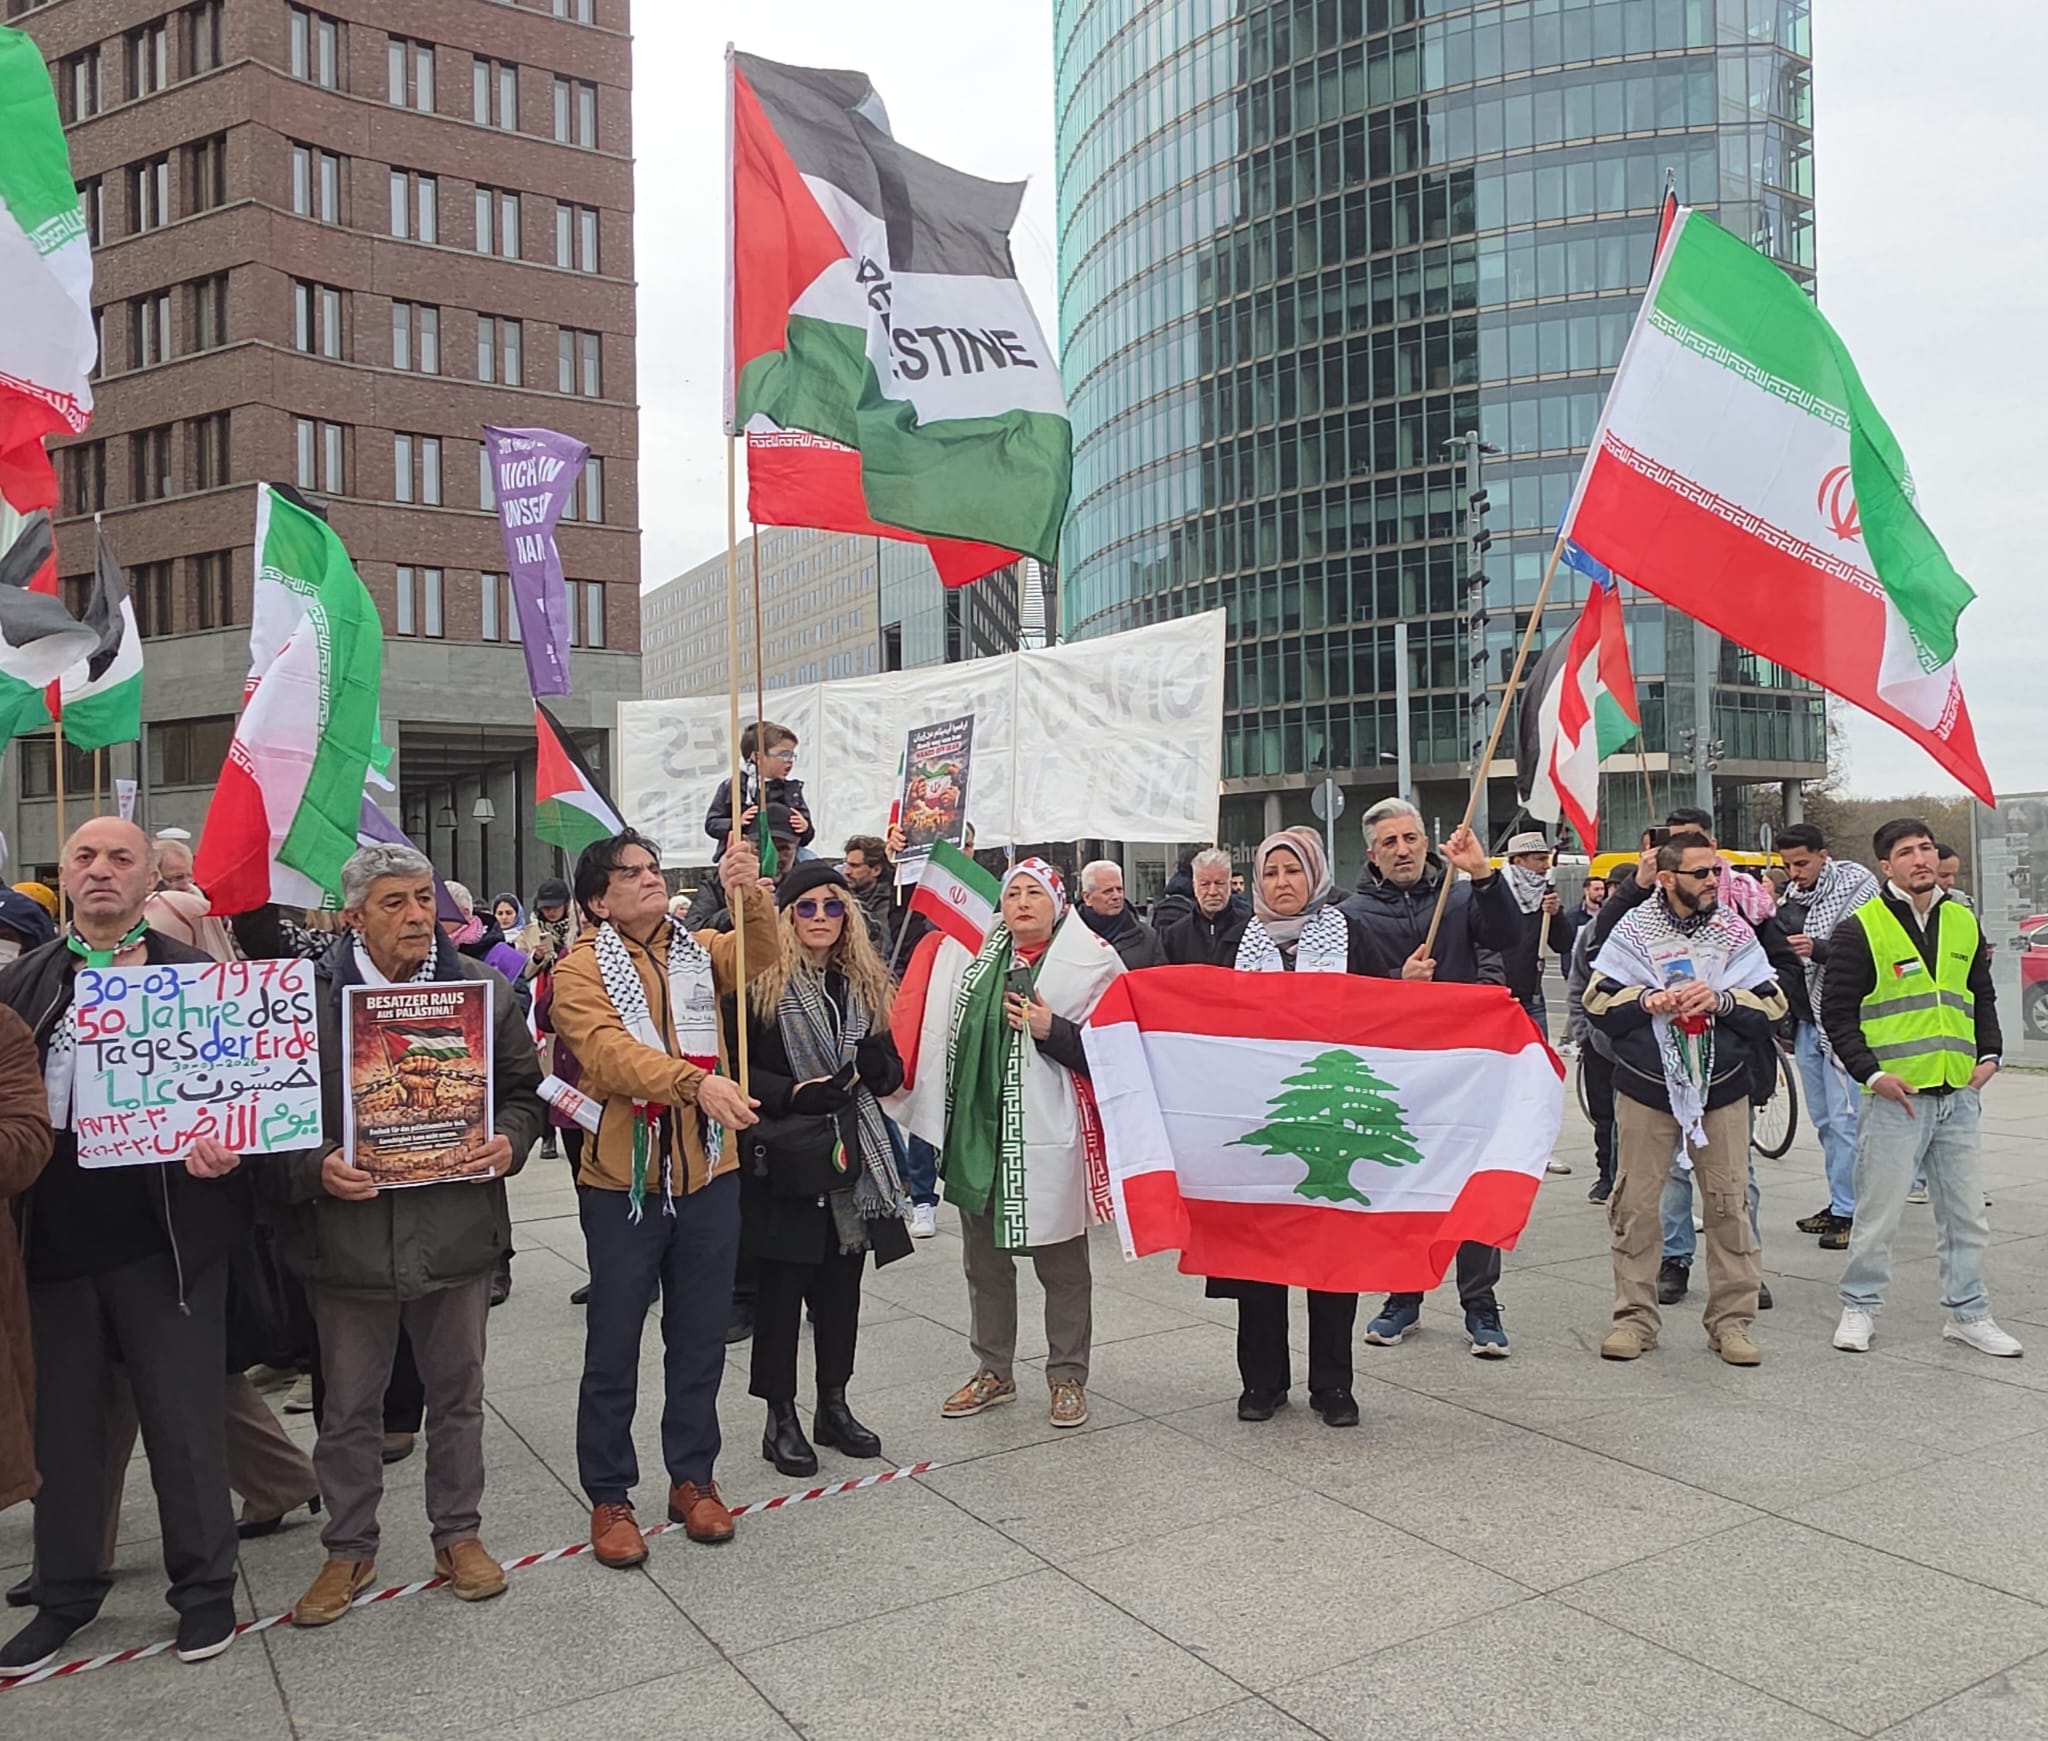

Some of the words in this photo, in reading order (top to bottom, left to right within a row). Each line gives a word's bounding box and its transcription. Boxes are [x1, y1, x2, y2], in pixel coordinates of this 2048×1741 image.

[77, 1007, 125, 1040] 50
[126, 989, 245, 1038] Jahre
[366, 994, 429, 1010] BESATZER
[431, 992, 465, 1005] RAUS
[377, 1009, 394, 1019] AUS
[396, 1004, 455, 1018] PALÄSTINA!
[78, 1031, 198, 1076] Tages
[200, 1015, 253, 1063] der
[255, 1014, 319, 1060] Erde
